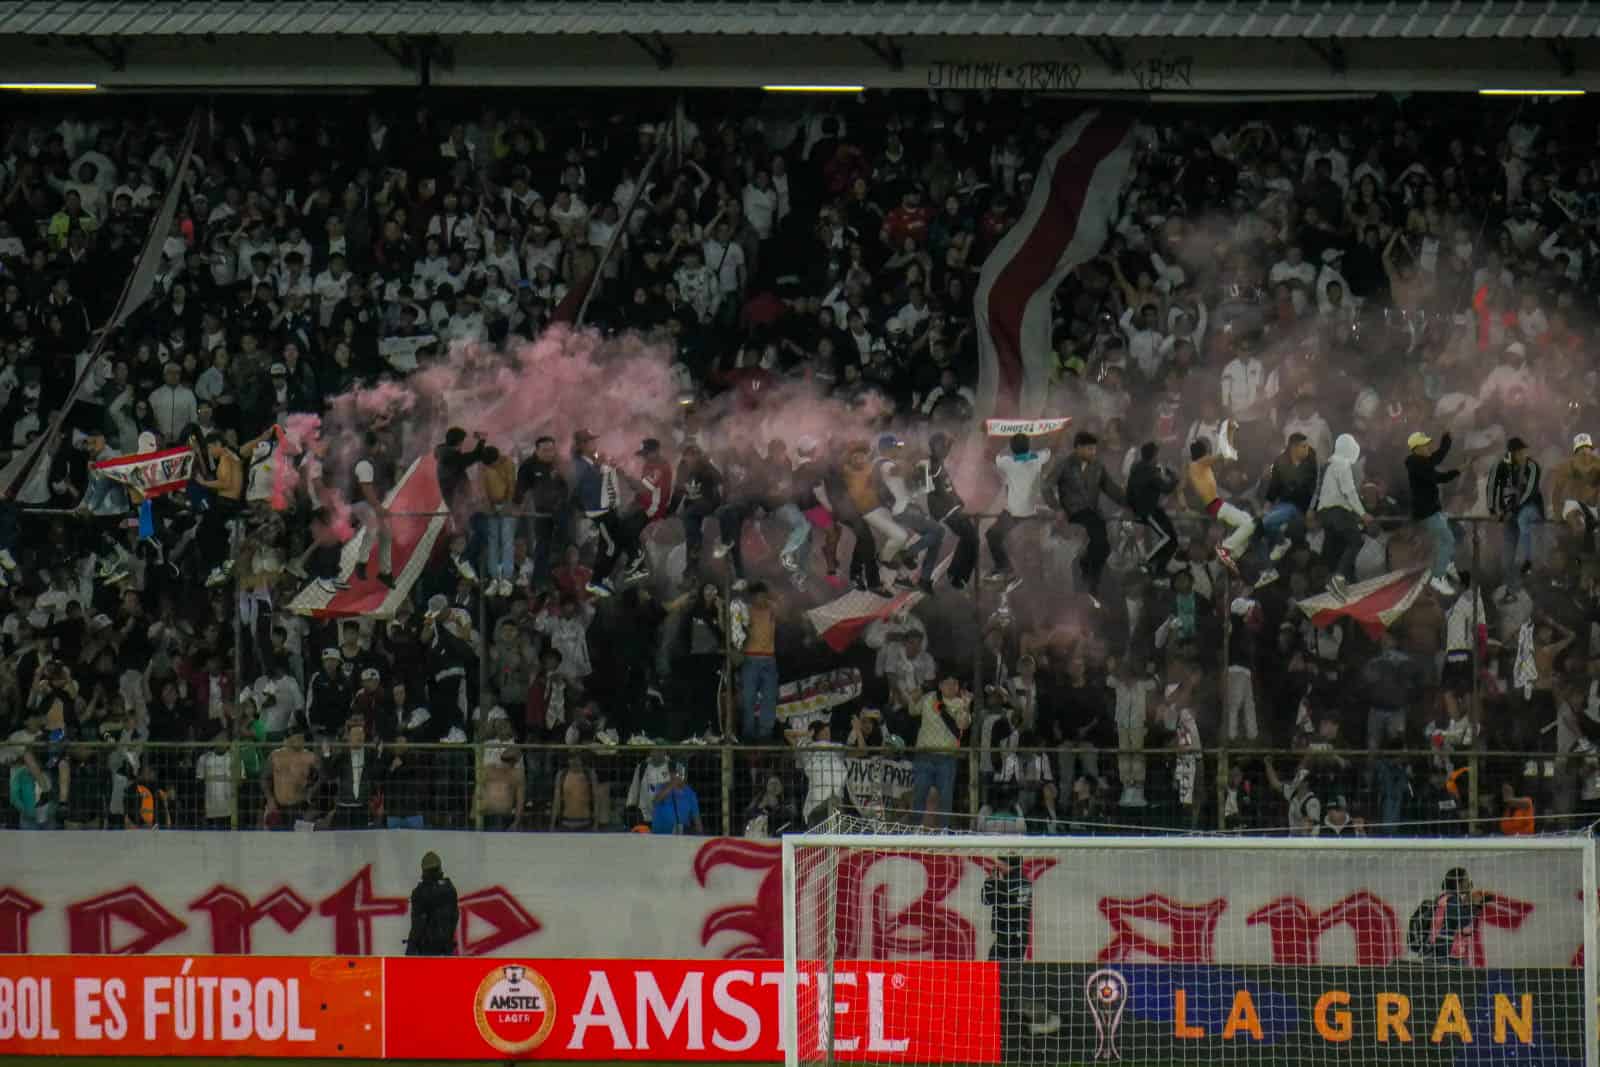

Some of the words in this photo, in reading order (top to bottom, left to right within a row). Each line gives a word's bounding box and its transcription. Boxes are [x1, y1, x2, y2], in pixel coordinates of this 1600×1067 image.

[74, 977, 128, 1040] ES
[144, 958, 316, 1041] FÚTBOL
[491, 995, 540, 1010] AMSTEL
[1174, 989, 1265, 1040] LA
[1313, 990, 1534, 1044] GRAN
